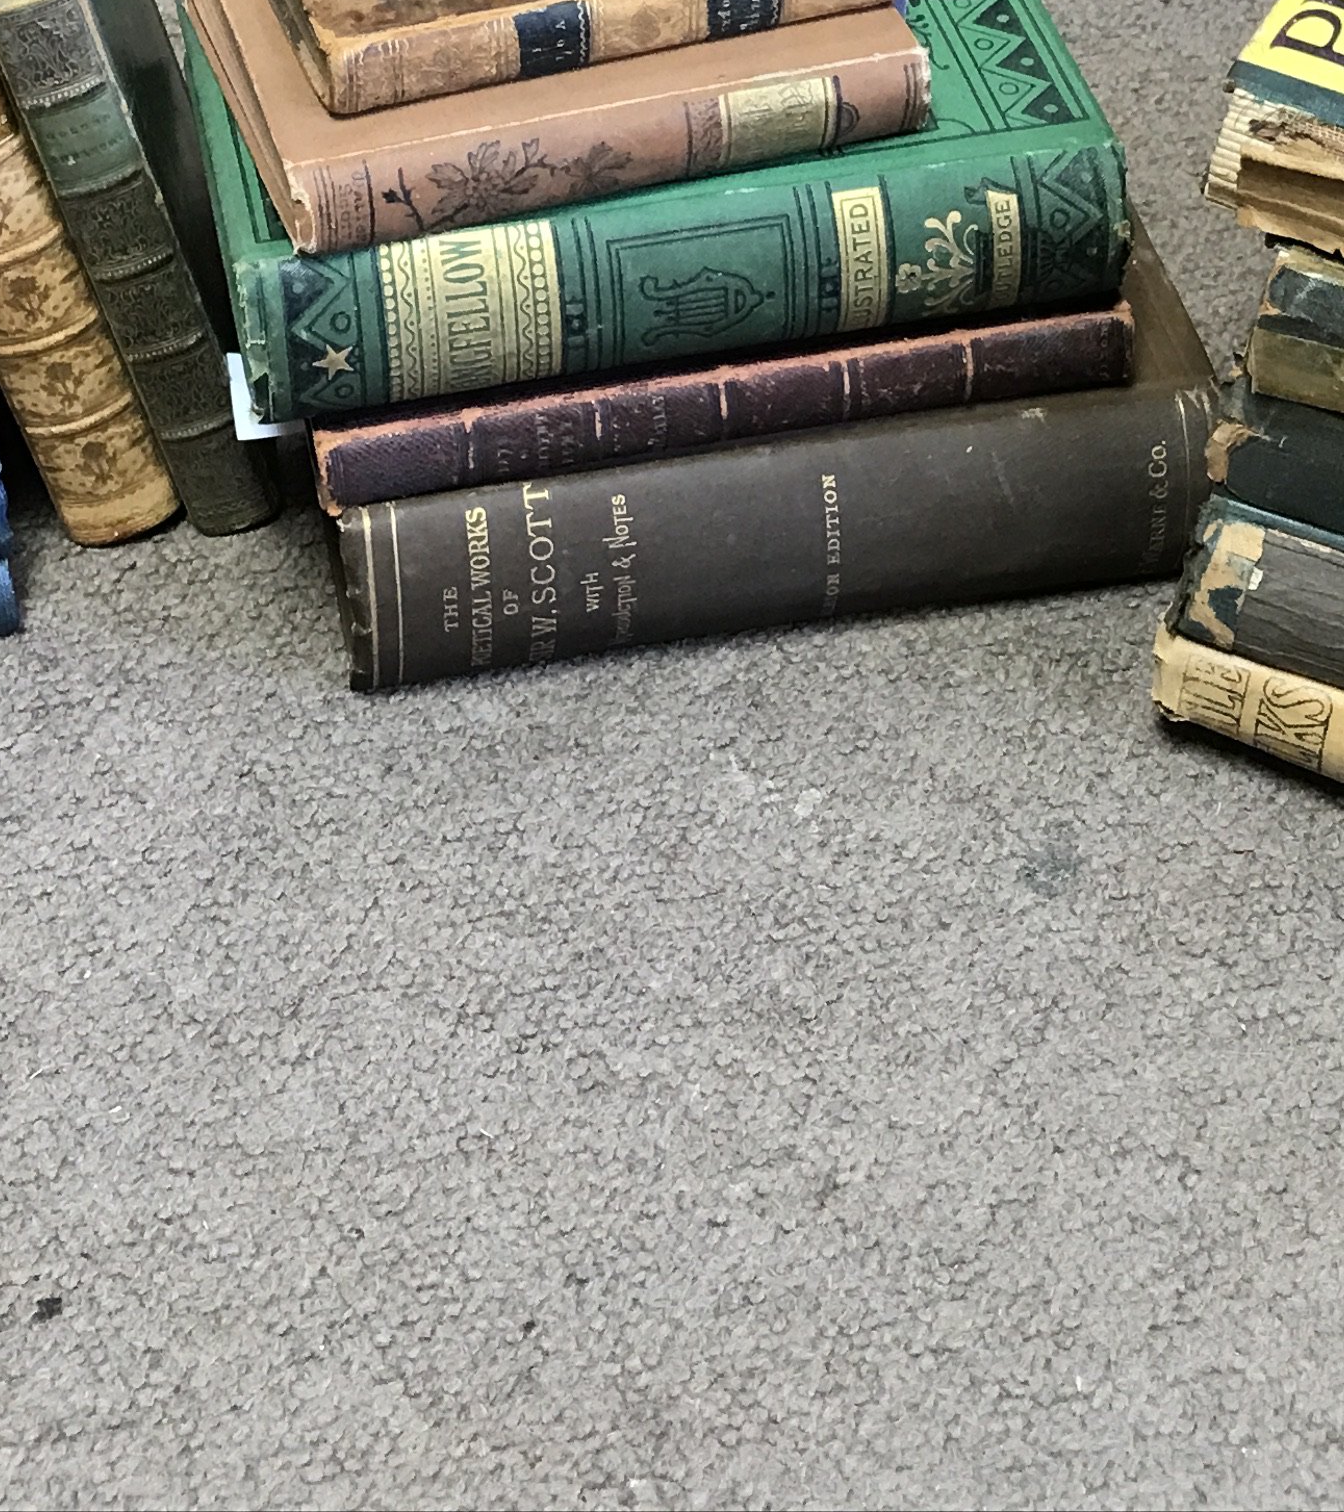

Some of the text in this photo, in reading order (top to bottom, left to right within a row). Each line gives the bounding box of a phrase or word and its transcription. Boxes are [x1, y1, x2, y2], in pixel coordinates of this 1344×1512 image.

[522, 482, 556, 605] SCOTT
[822, 474, 841, 566] EDITION
[465, 506, 491, 591] WORKS
[611, 552, 636, 569] &
[443, 586, 459, 633] THE
[502, 588, 518, 616] OF
[580, 571, 604, 613] WITH
